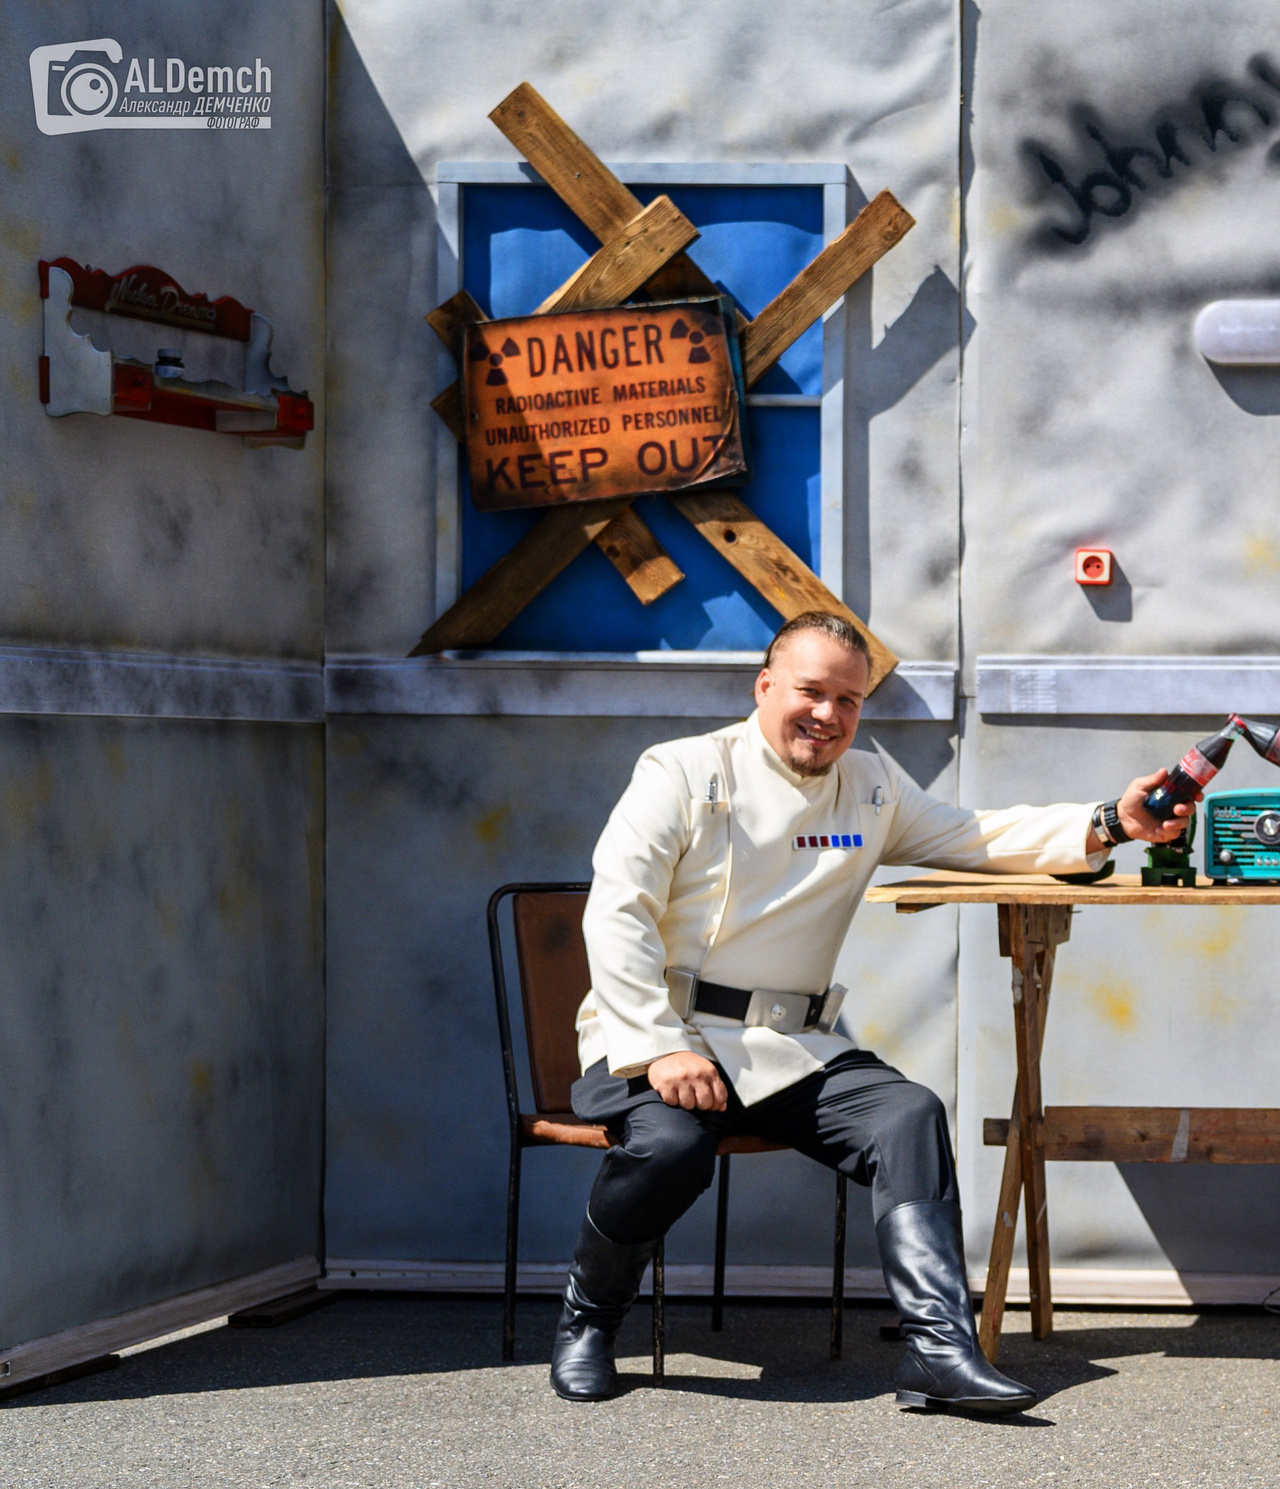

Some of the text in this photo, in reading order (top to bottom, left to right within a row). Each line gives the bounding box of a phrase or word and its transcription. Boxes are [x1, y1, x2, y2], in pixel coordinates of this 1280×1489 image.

[527, 324, 664, 378] DANGER
[496, 376, 705, 415] RADIOACTIVE MATERIALS
[485, 405, 723, 446] UNAUTHORIZED PERSONNEL
[486, 447, 608, 491] KEEP
